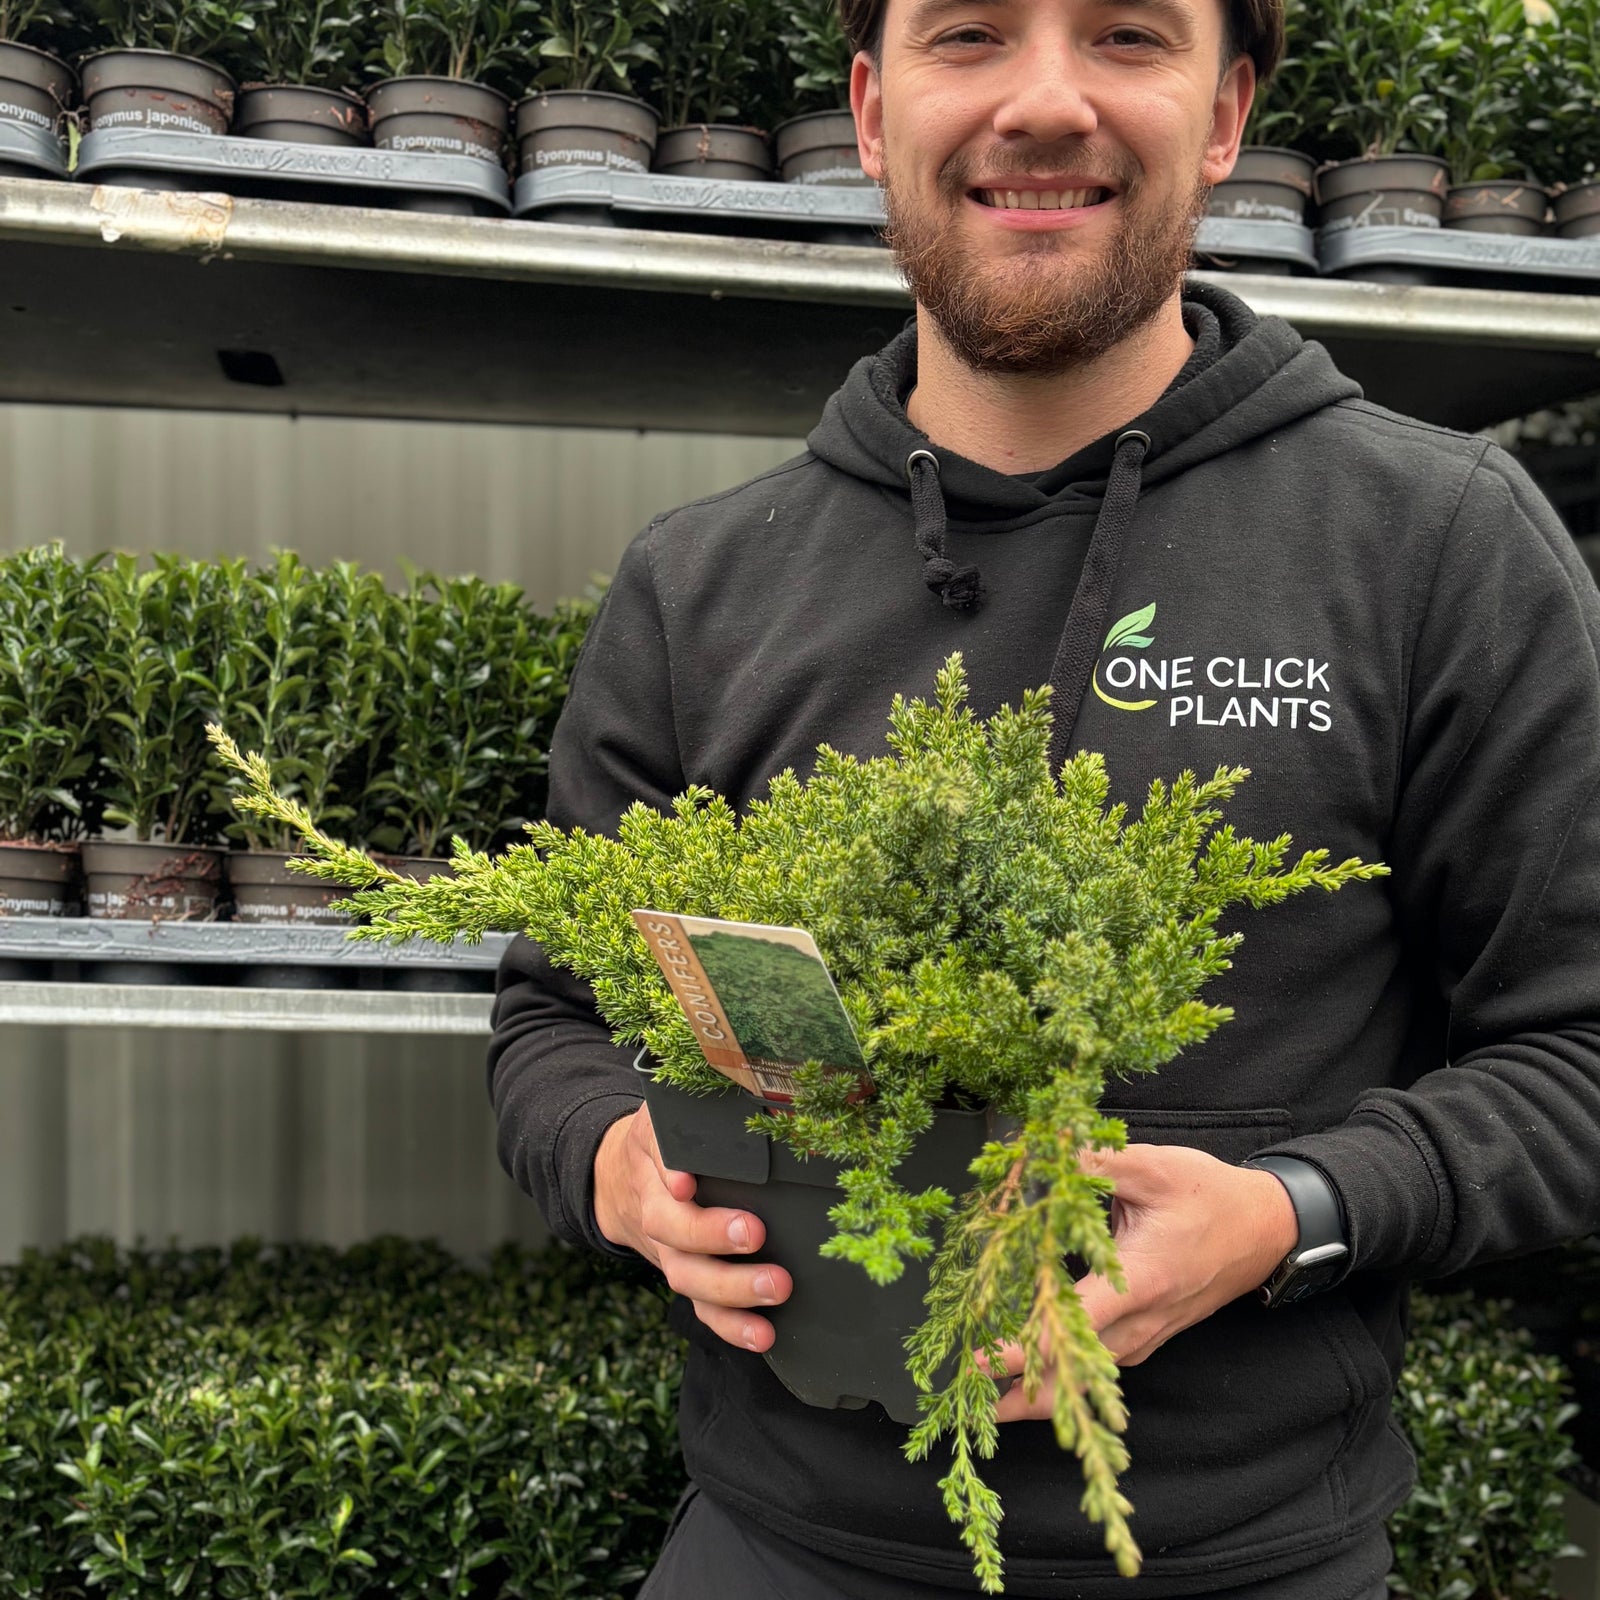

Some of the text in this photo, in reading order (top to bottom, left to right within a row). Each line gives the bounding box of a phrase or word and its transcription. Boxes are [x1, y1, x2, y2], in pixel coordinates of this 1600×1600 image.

[1105, 656, 1331, 693] ONE CLICK
[1169, 694, 1333, 732] PLANTS
[647, 921, 725, 1040] CONIFERS
